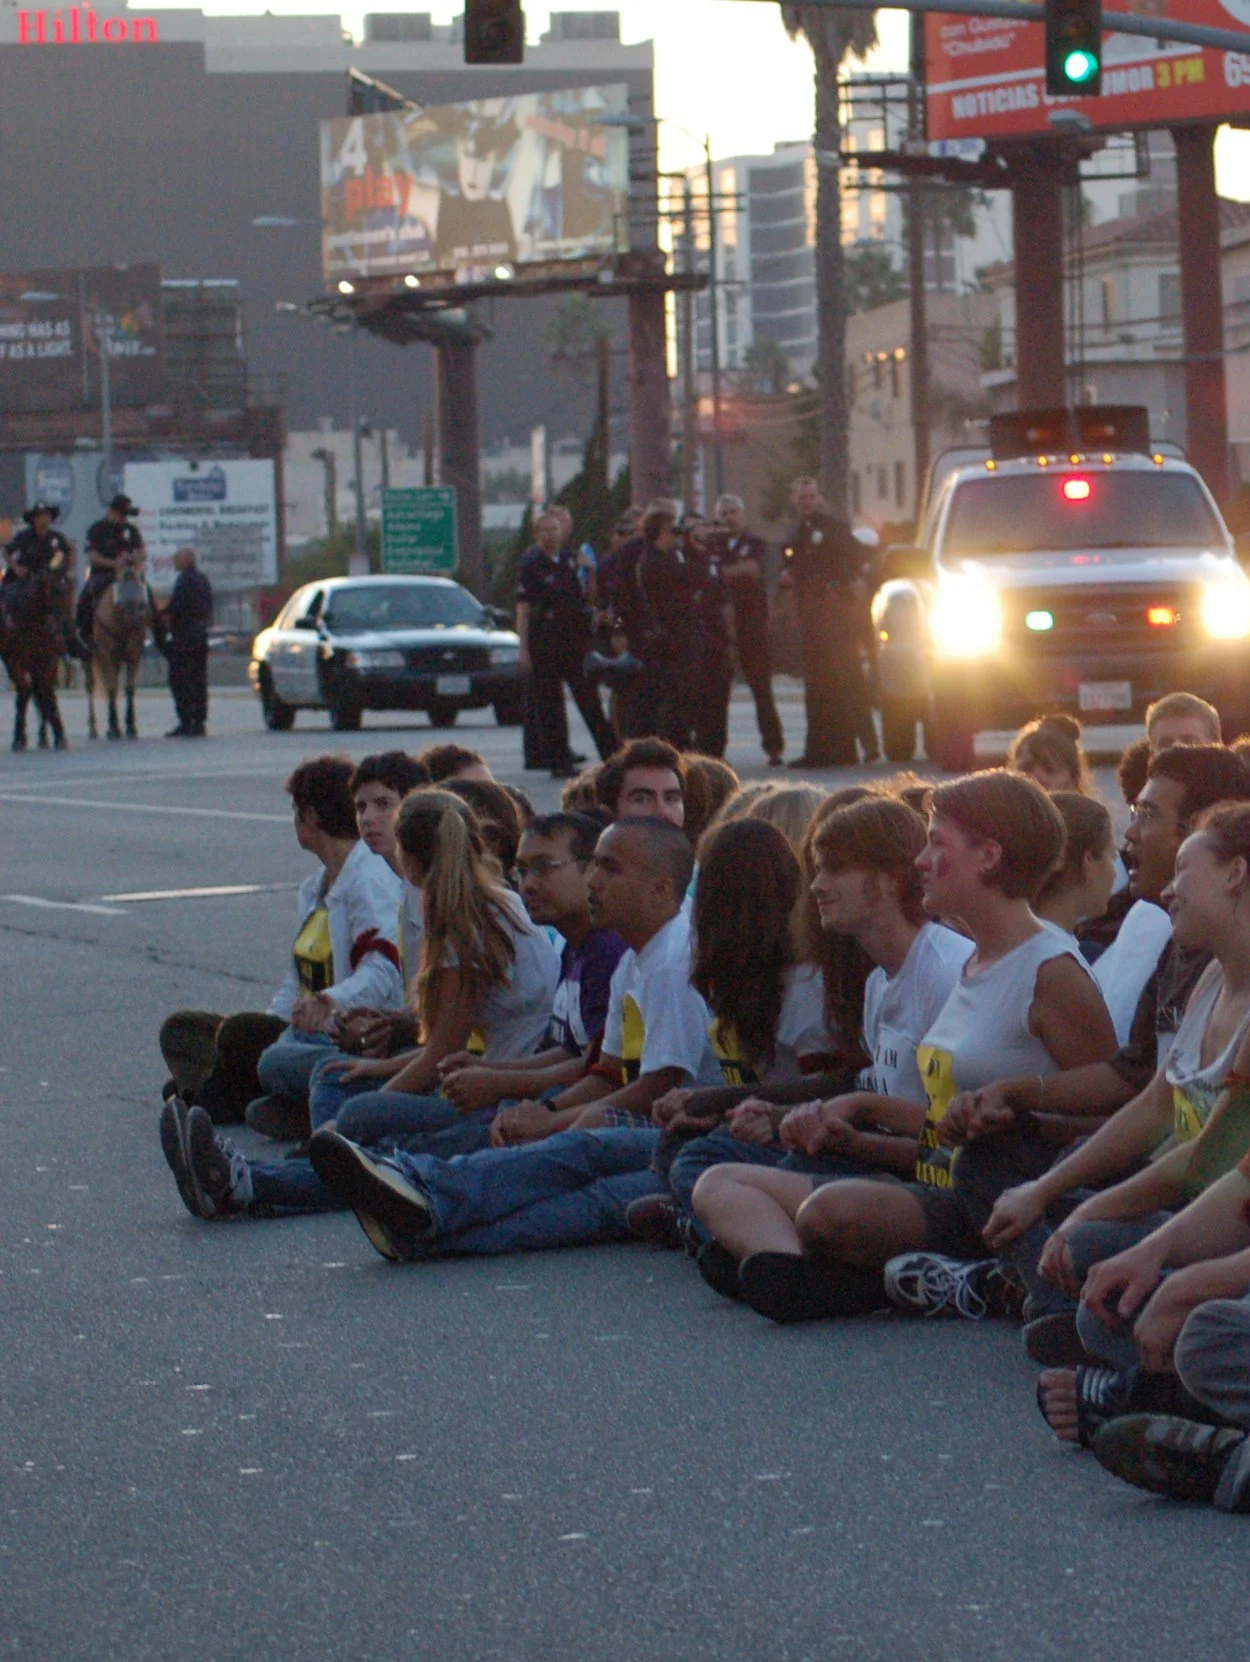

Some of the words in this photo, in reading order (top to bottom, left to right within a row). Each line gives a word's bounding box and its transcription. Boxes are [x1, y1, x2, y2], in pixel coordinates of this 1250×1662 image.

[16, 5, 158, 45] Hilton
[951, 83, 1039, 120] NOTICIAS
[1156, 62, 1170, 88] 3
[1174, 58, 1204, 85] PM
[340, 117, 367, 175] 4
[345, 165, 414, 220] play
